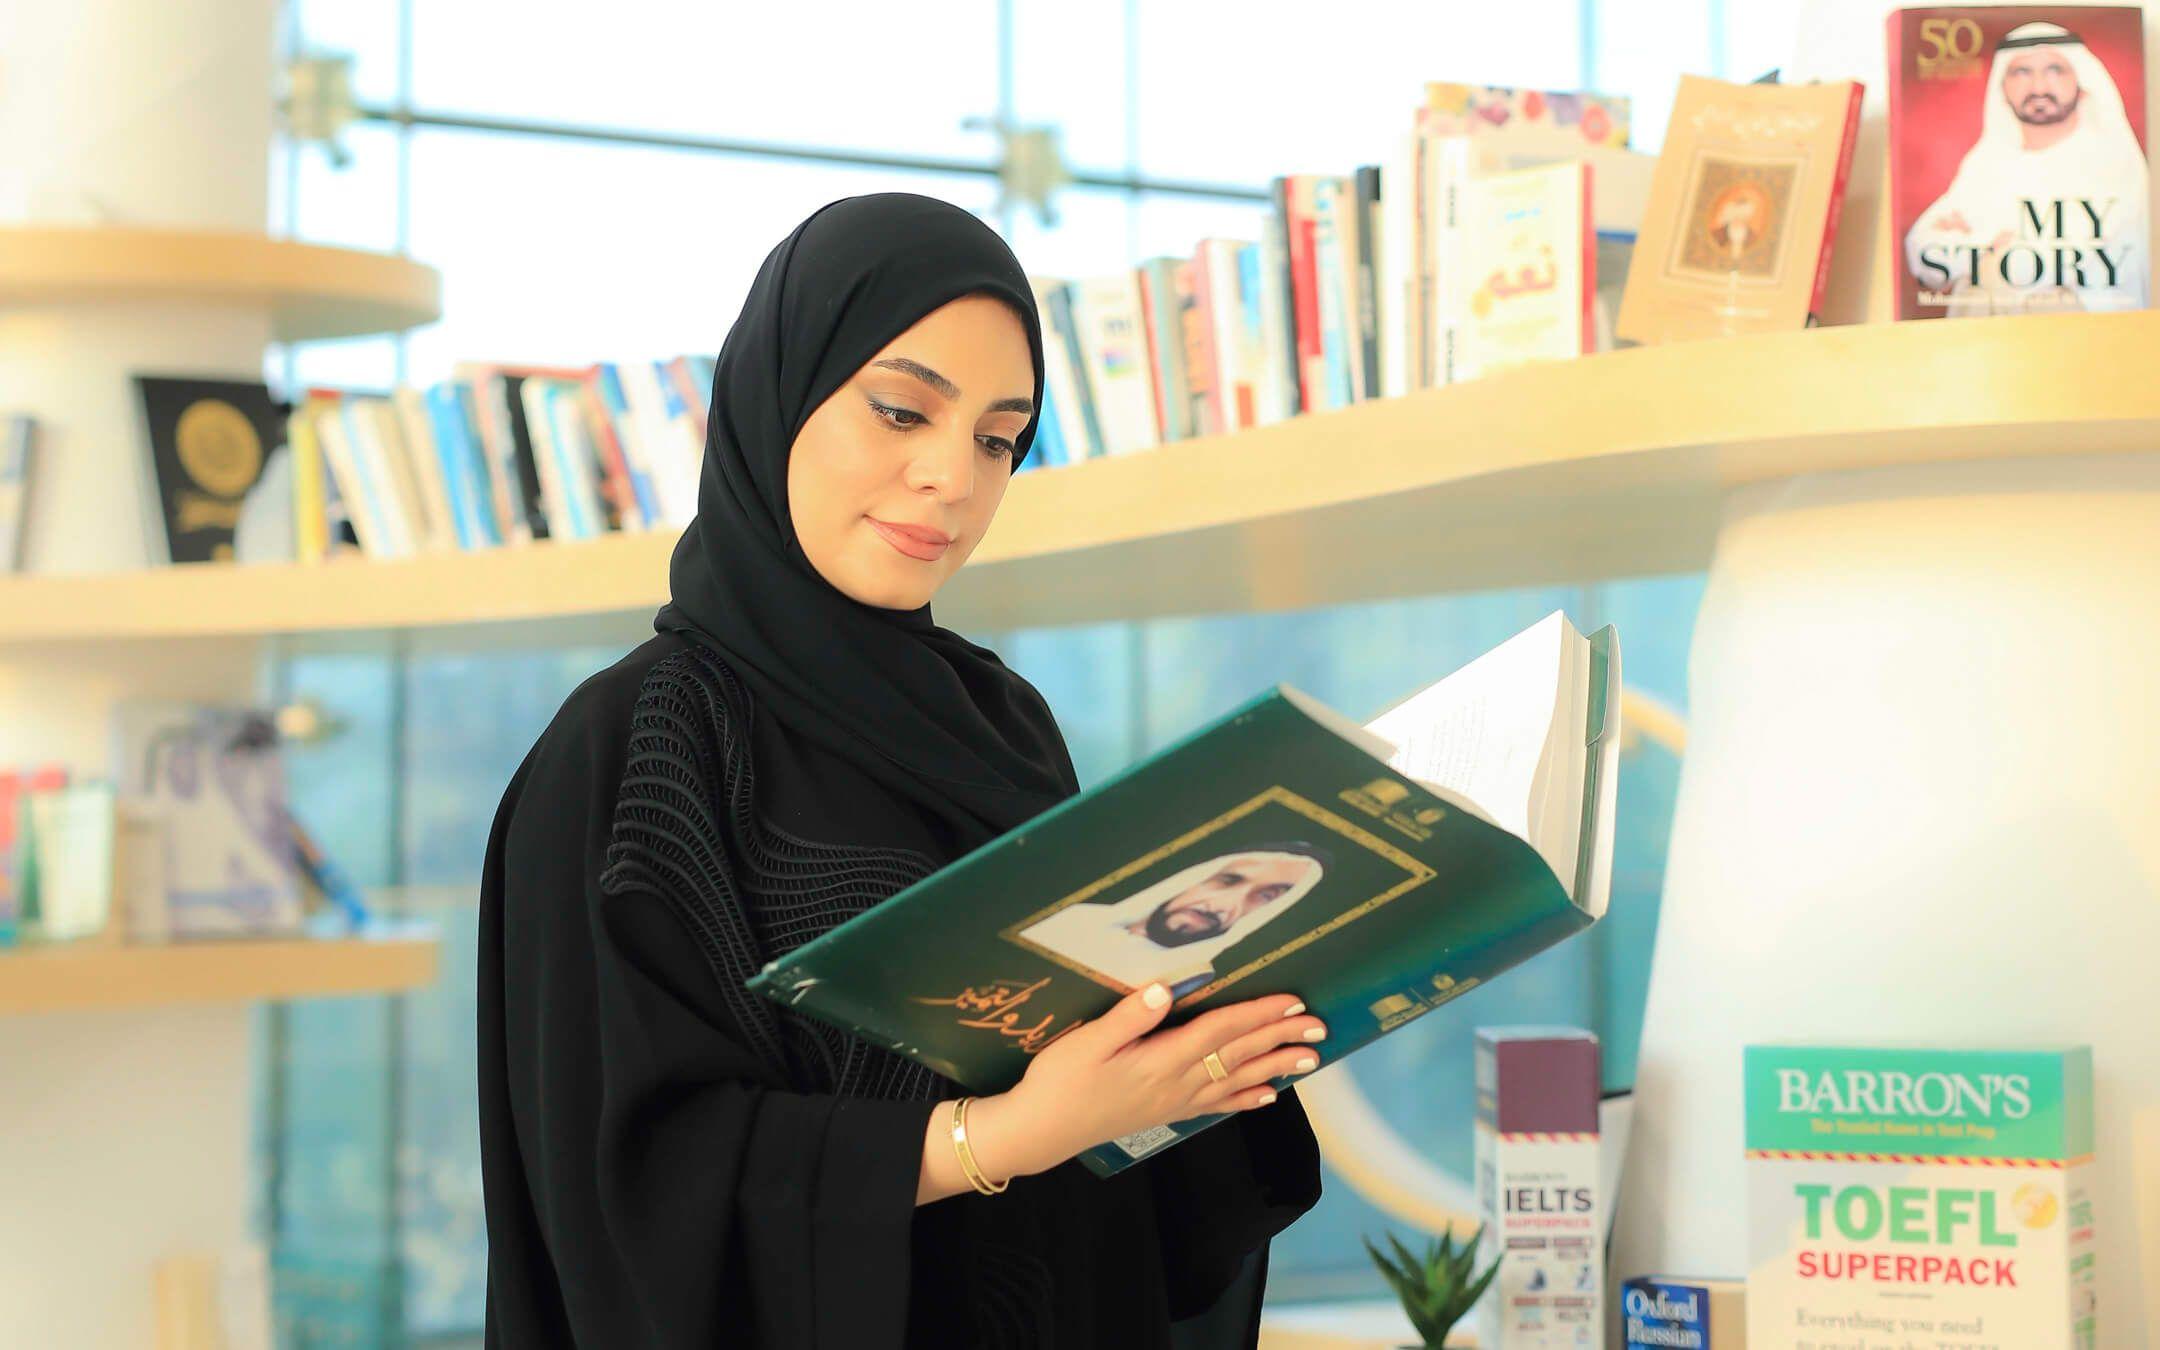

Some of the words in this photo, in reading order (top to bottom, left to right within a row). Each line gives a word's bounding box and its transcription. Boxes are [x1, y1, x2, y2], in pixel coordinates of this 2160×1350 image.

[1917, 18, 1984, 67] 50
[2019, 198, 2118, 239] MY
[1918, 245, 2132, 287] STORY
[1775, 1068, 2032, 1119] BARRON'S
[1505, 1188, 1592, 1212] IELTS
[1795, 1184, 2018, 1247] TOEFL
[1797, 1251, 2018, 1287] SUPERPACK
[1626, 1289, 1698, 1322] Oxford
